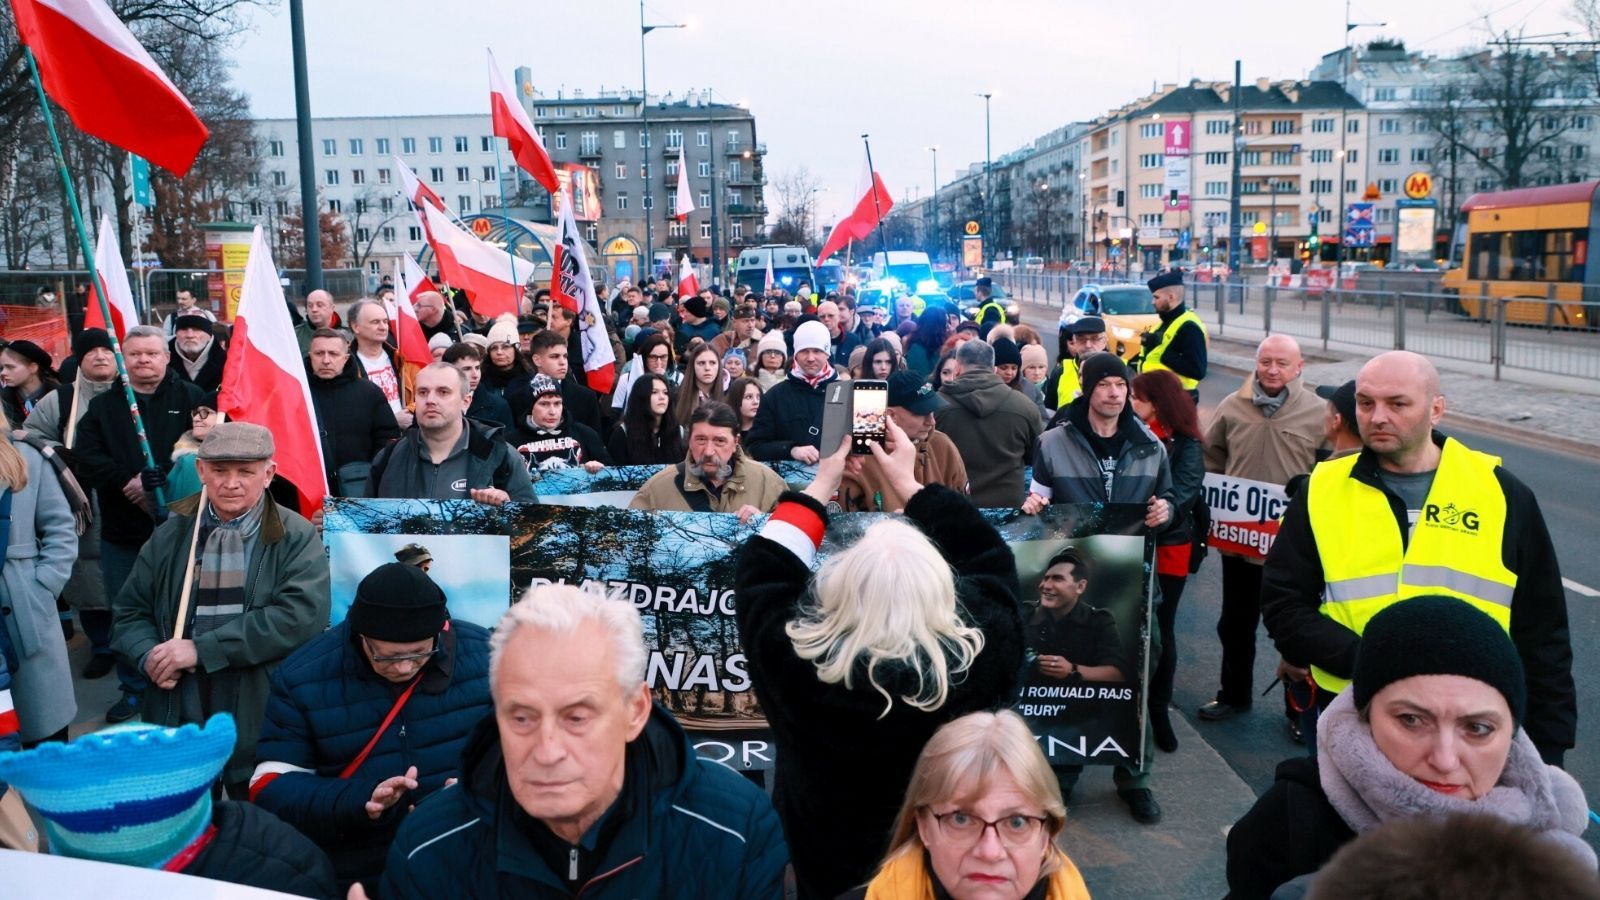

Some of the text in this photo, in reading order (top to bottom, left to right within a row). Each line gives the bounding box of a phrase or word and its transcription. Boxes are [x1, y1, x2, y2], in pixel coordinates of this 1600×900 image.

[1410, 177, 1428, 193] M
[475, 221, 489, 233] M
[1207, 519, 1277, 555] łasneg
[646, 651, 752, 692] NAS
[1028, 687, 1095, 699] ROMUALD
[1098, 688, 1133, 700] RAJS
[1033, 735, 1130, 758] NA
